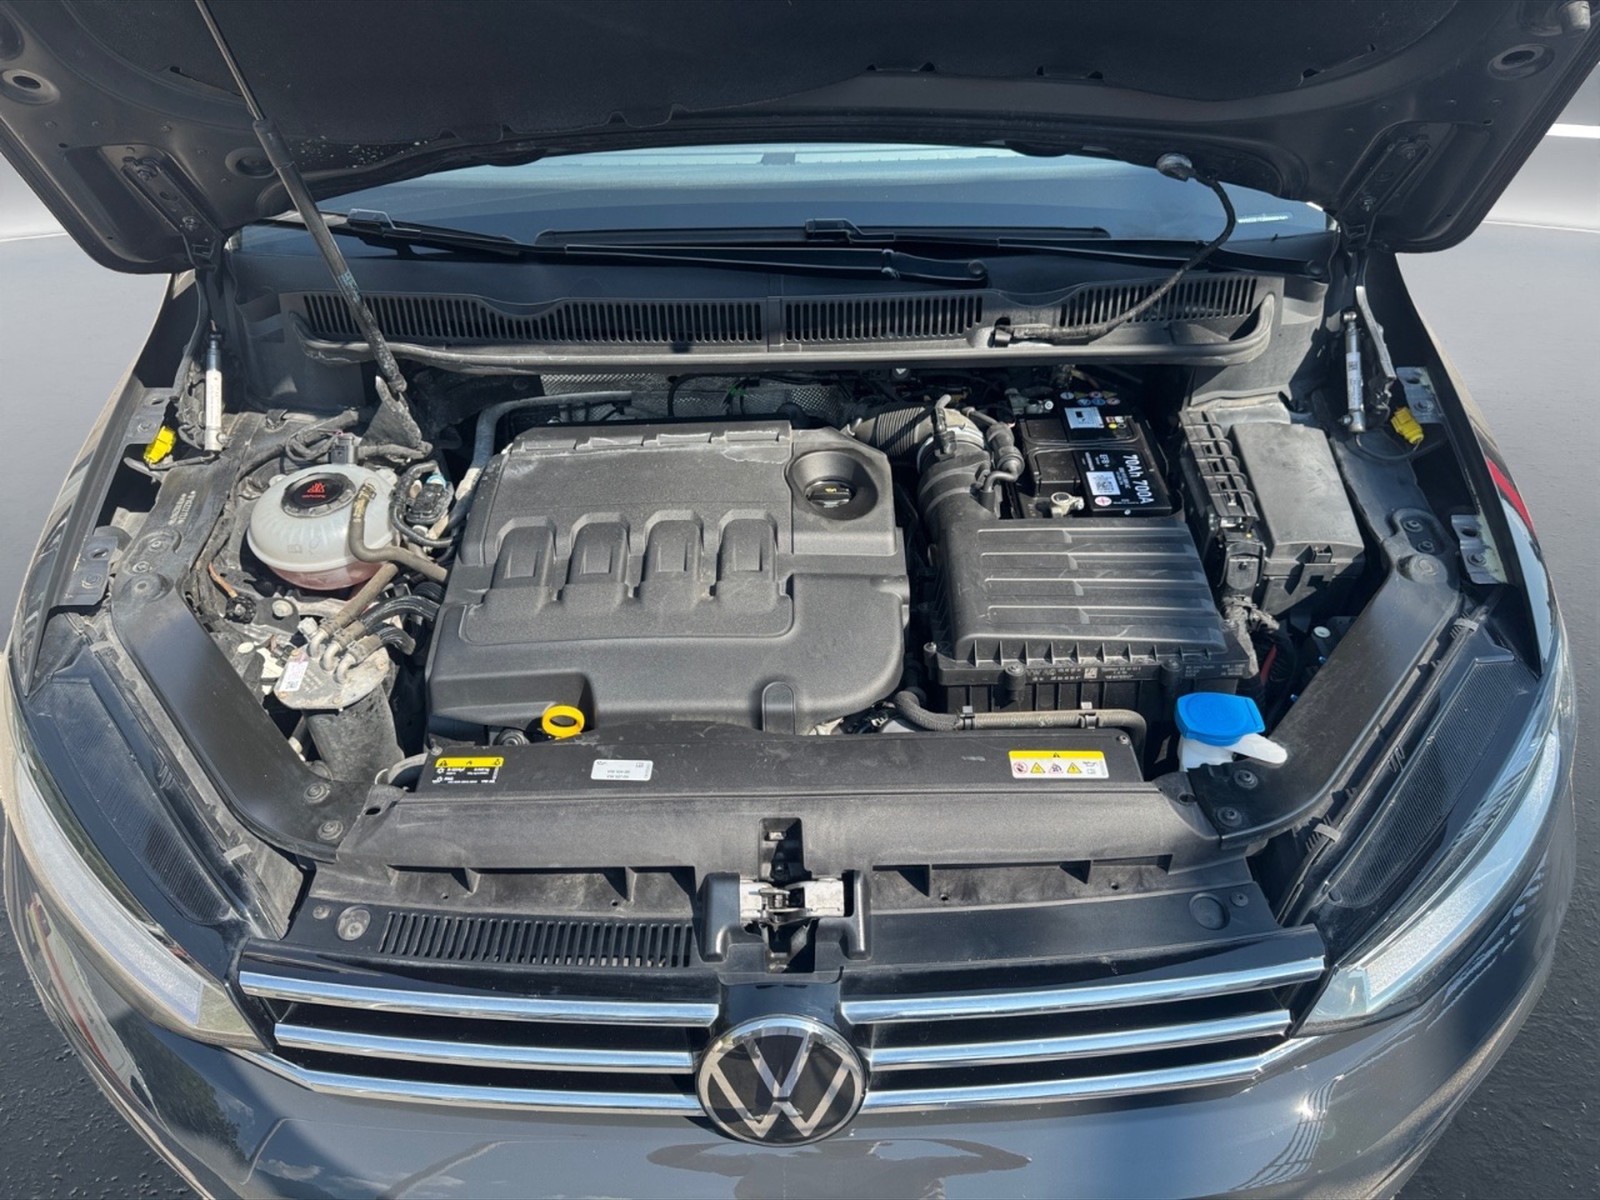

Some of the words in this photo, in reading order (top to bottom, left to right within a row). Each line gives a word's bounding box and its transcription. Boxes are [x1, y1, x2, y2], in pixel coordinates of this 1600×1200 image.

[1123, 454, 1144, 478] 70Ah
[1132, 480, 1155, 504] 700A
[706, 1028, 856, 1140] VW
